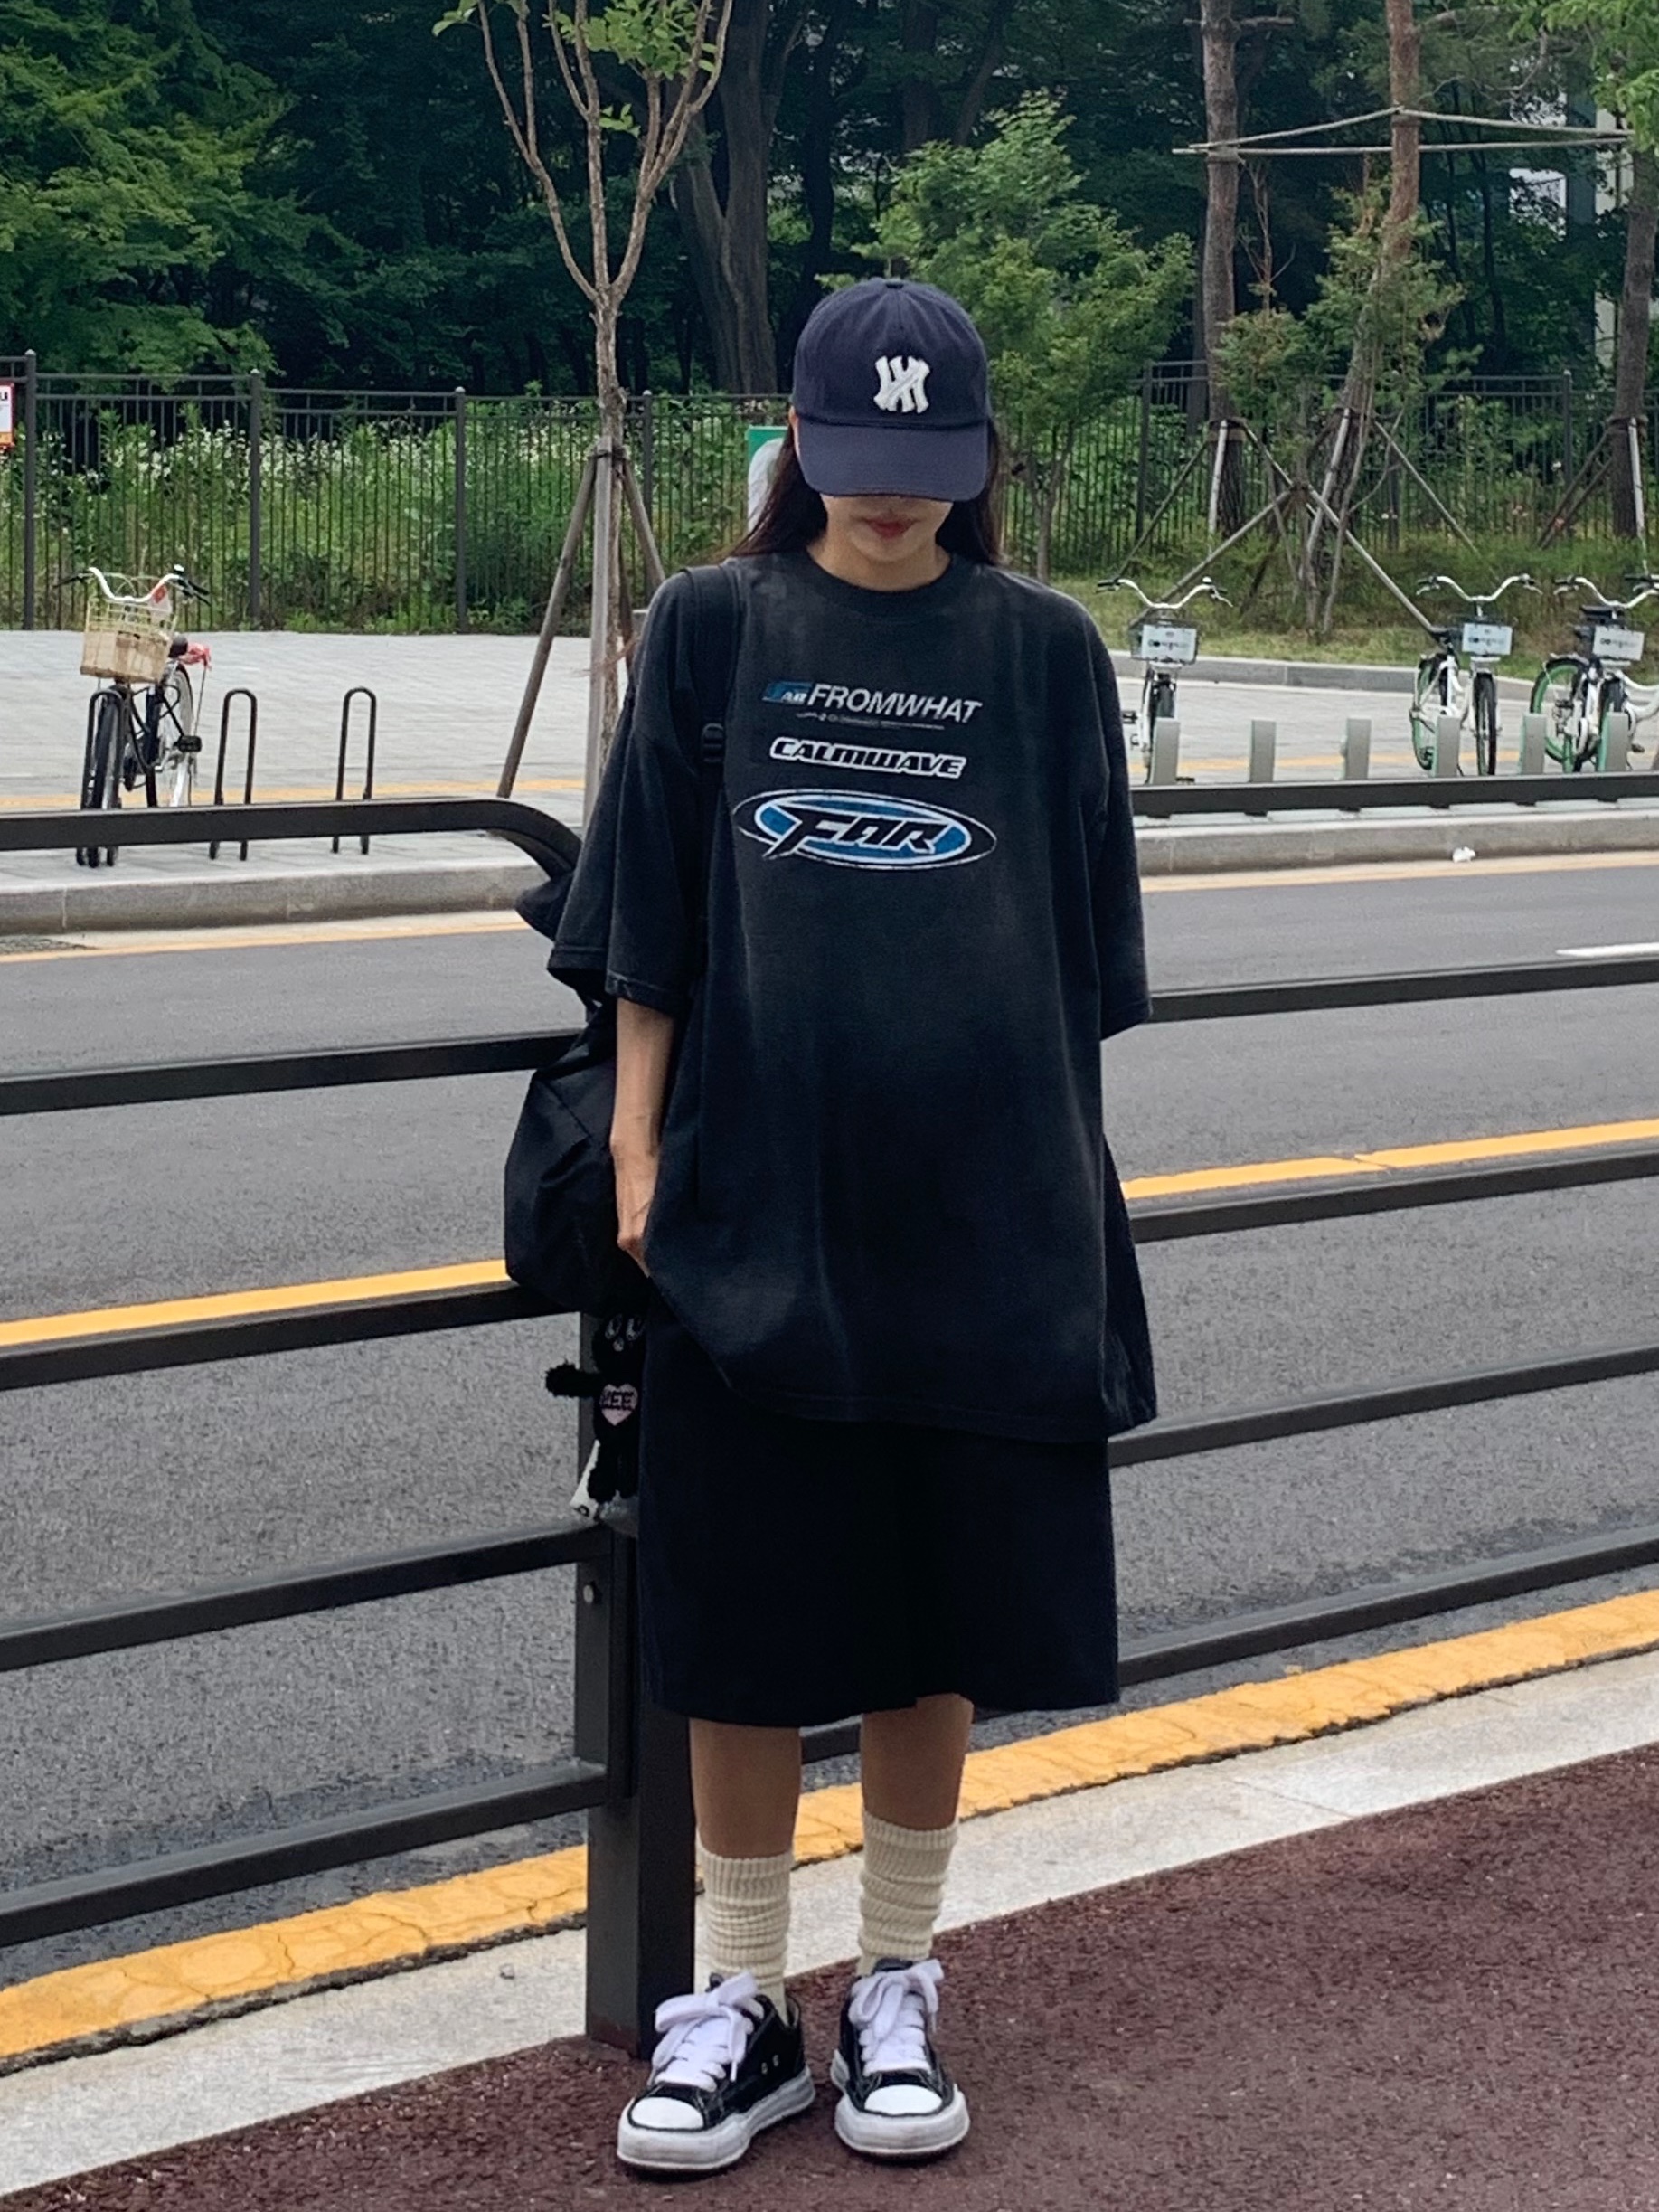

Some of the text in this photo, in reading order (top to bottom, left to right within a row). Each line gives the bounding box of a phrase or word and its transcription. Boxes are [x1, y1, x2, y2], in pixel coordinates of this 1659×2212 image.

[807, 683, 983, 723] FROMWHAT
[770, 737, 966, 779] CALMWAVE
[764, 802, 949, 858] FAR
